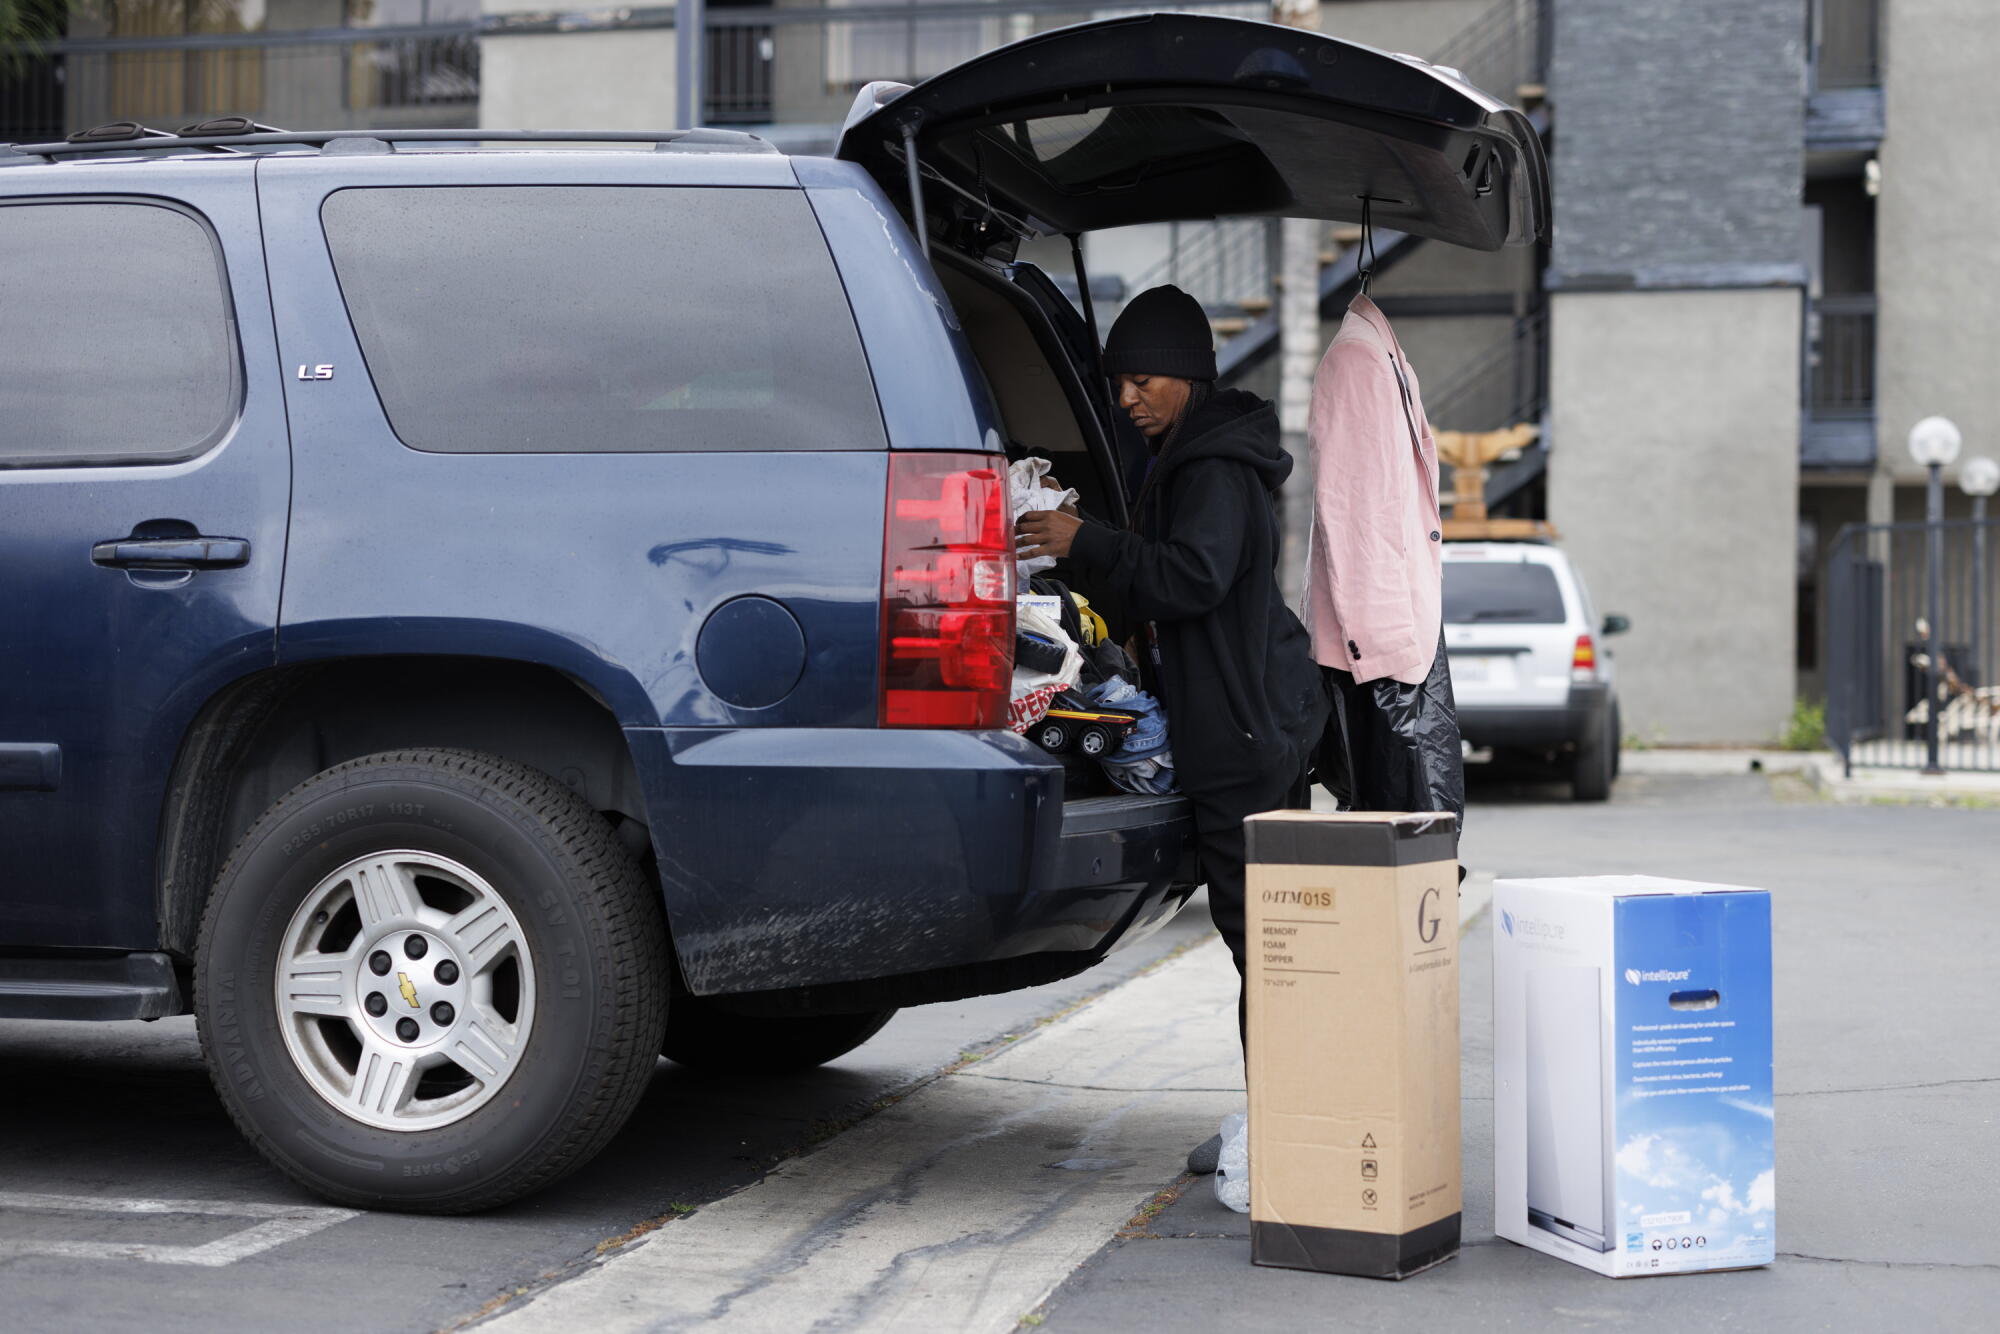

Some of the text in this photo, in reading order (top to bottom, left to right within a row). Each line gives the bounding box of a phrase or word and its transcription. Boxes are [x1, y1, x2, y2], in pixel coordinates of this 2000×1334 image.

[298, 364, 334, 381] LS
[281, 802, 425, 857] P265/70R17 113T
[1417, 887, 1441, 944] G
[1262, 927, 1298, 936] MEMORY
[1262, 940, 1287, 949] FOAM
[1263, 954, 1294, 964] TOPPER
